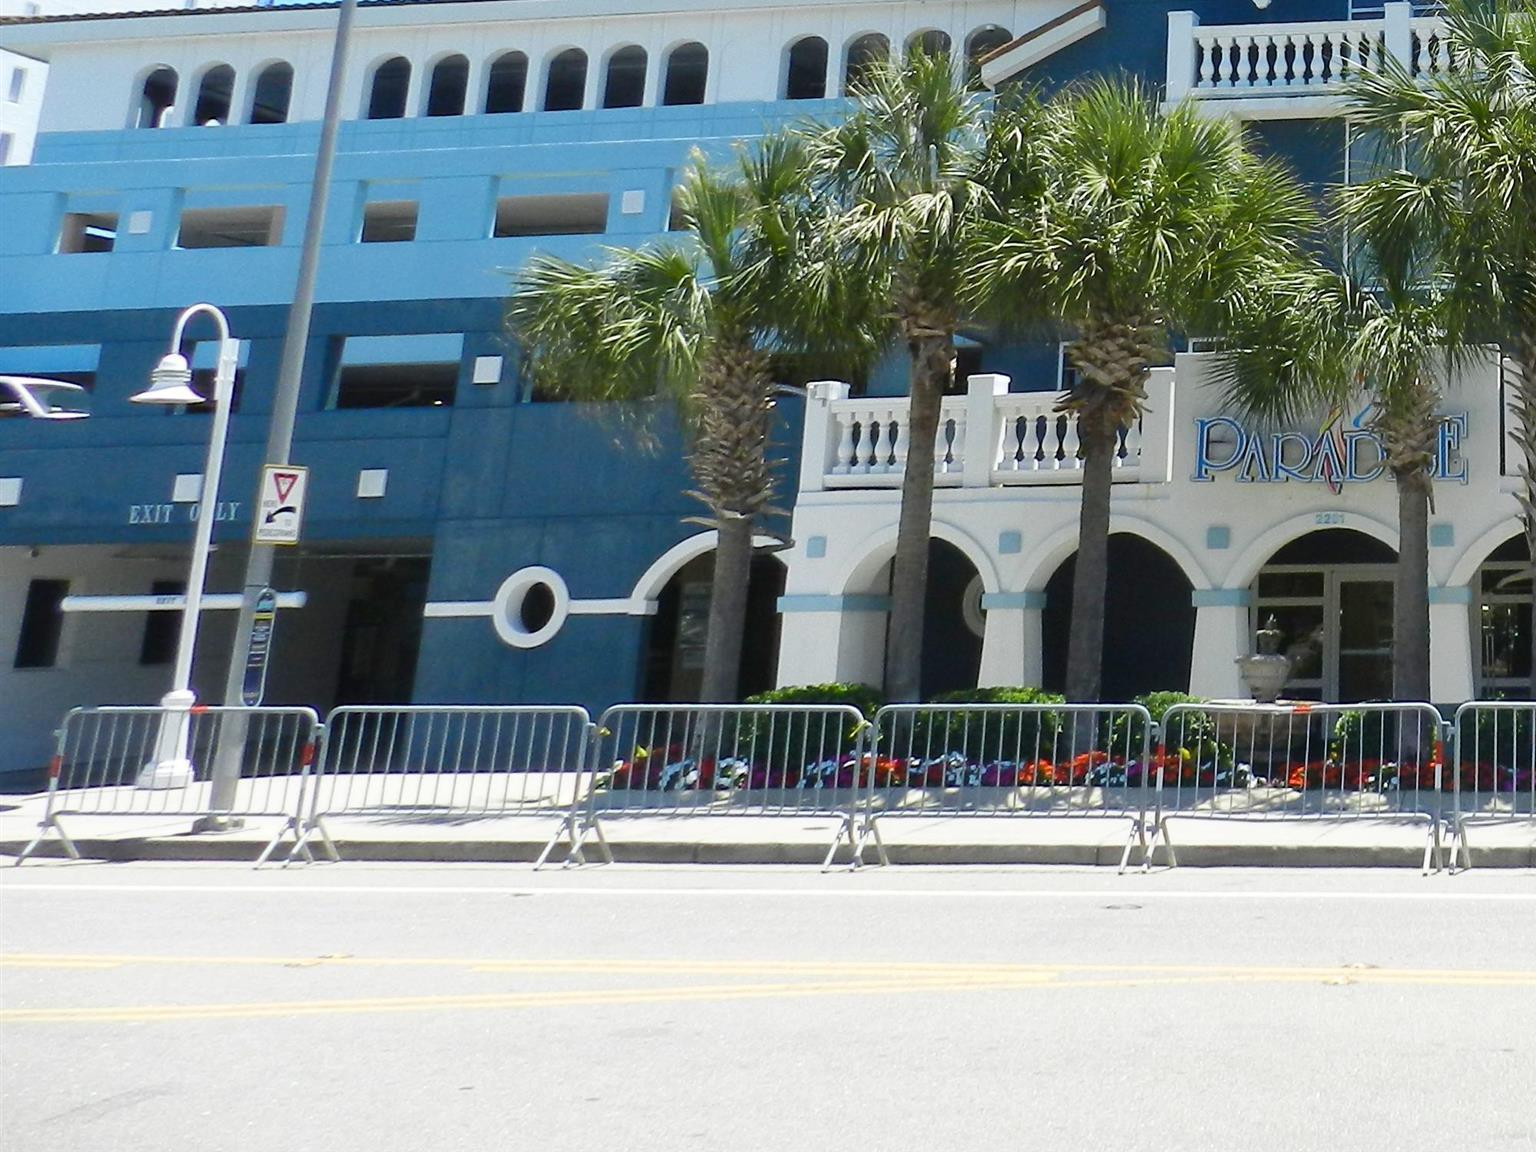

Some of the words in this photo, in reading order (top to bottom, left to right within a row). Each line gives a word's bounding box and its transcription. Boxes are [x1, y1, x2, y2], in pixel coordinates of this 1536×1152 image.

[1190, 410, 1469, 486] PARADE
[128, 504, 174, 524] EXIT
[189, 501, 242, 522] OLY
